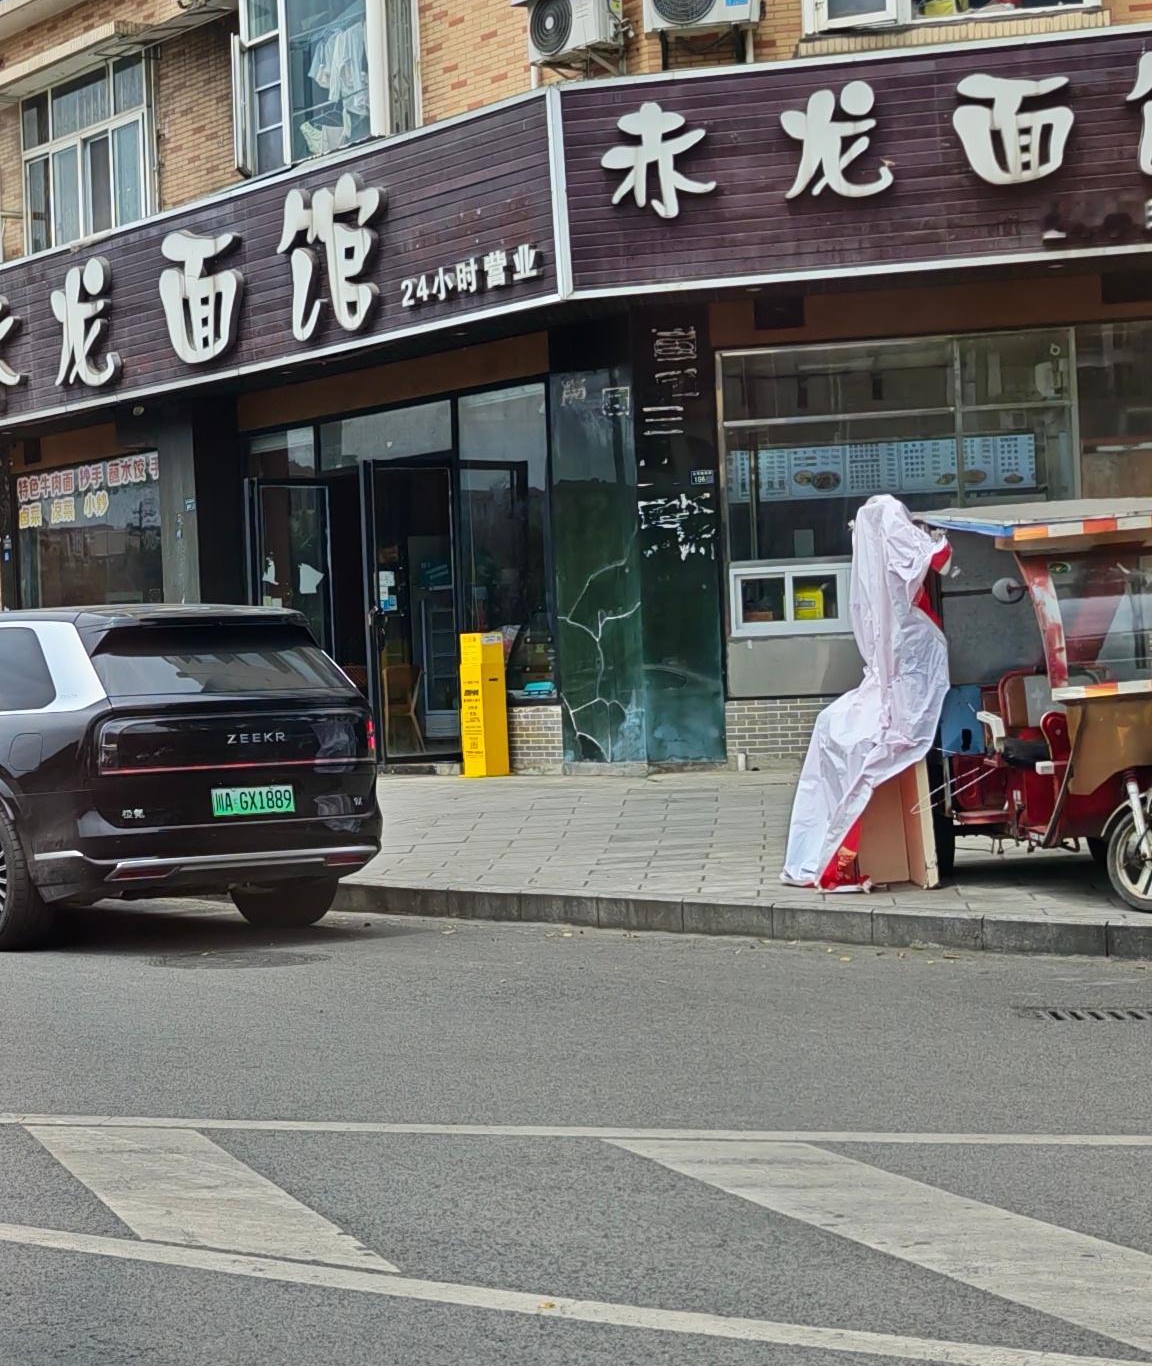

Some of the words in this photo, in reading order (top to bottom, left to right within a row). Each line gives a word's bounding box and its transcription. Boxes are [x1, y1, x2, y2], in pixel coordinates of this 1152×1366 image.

[601, 51, 1152, 218] 赤龙面
[401, 244, 538, 307] 24小时营业
[17, 471, 74, 501] 特色牛肉面
[79, 463, 102, 490] 抄手
[19, 503, 42, 529] 卤菜
[51, 498, 75, 523] 凉菜
[84, 490, 108, 518] 小炒
[227, 732, 286, 745] ZEEKR
